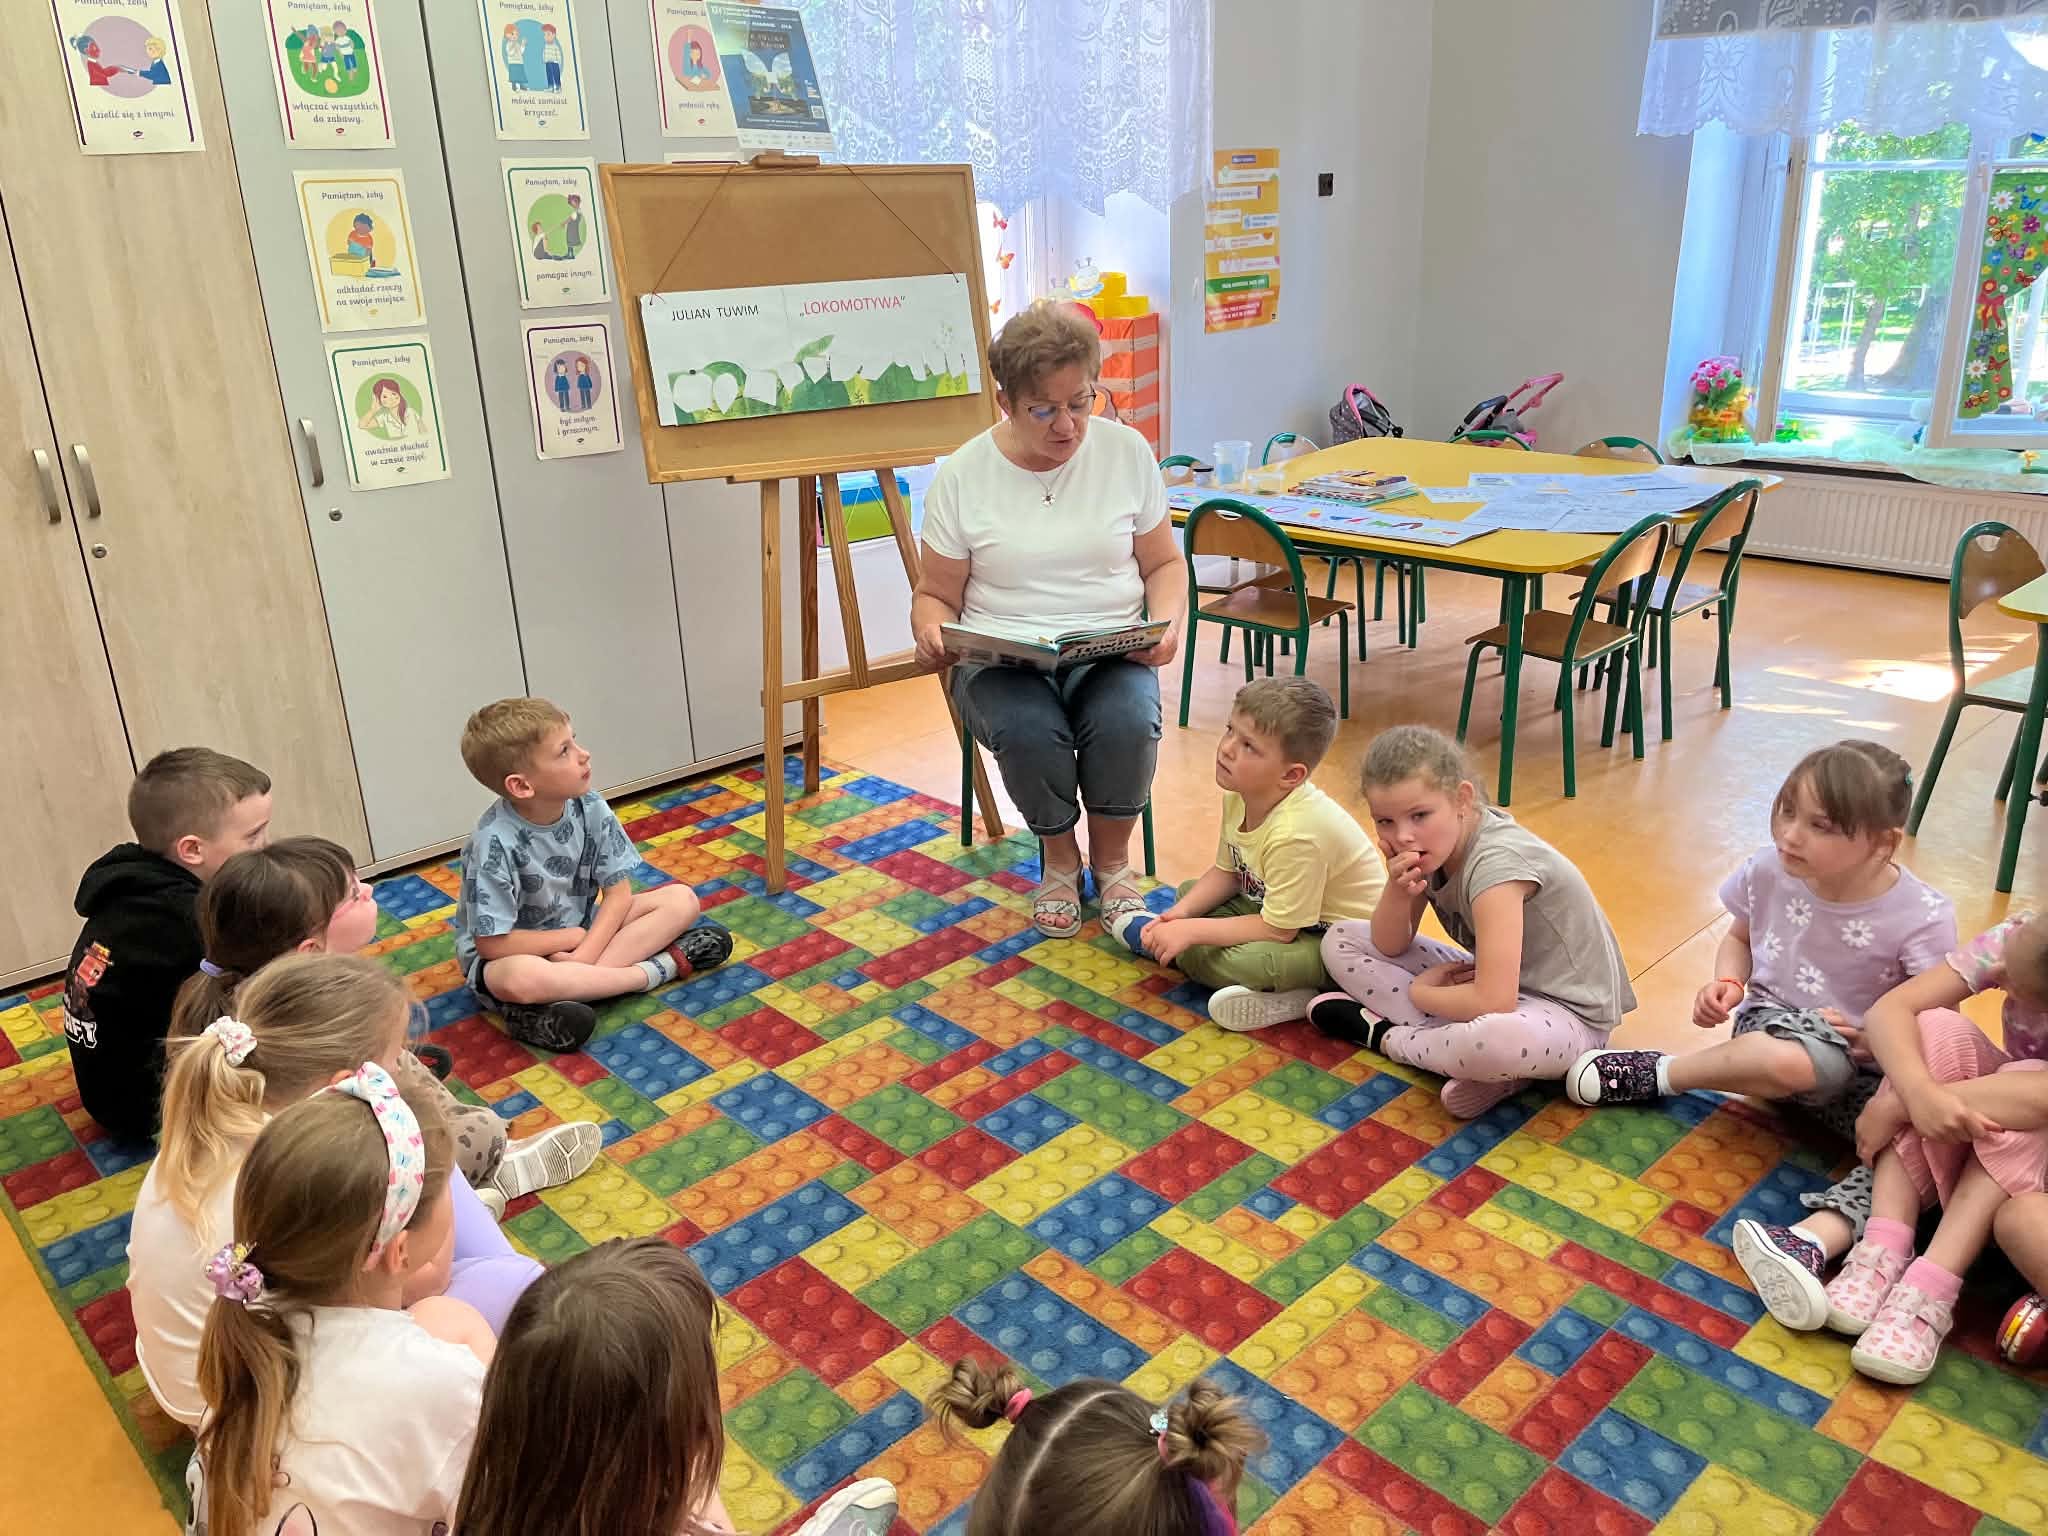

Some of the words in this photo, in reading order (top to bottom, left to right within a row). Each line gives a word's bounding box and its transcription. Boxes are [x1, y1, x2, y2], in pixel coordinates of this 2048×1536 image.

[292, 101, 329, 113] włączać
[331, 101, 379, 112] wszystkich
[121, 111, 136, 121] się
[312, 114, 325, 123] do
[335, 298, 348, 307] na
[671, 307, 711, 321] JULIAN
[715, 304, 759, 319] TUWIM
